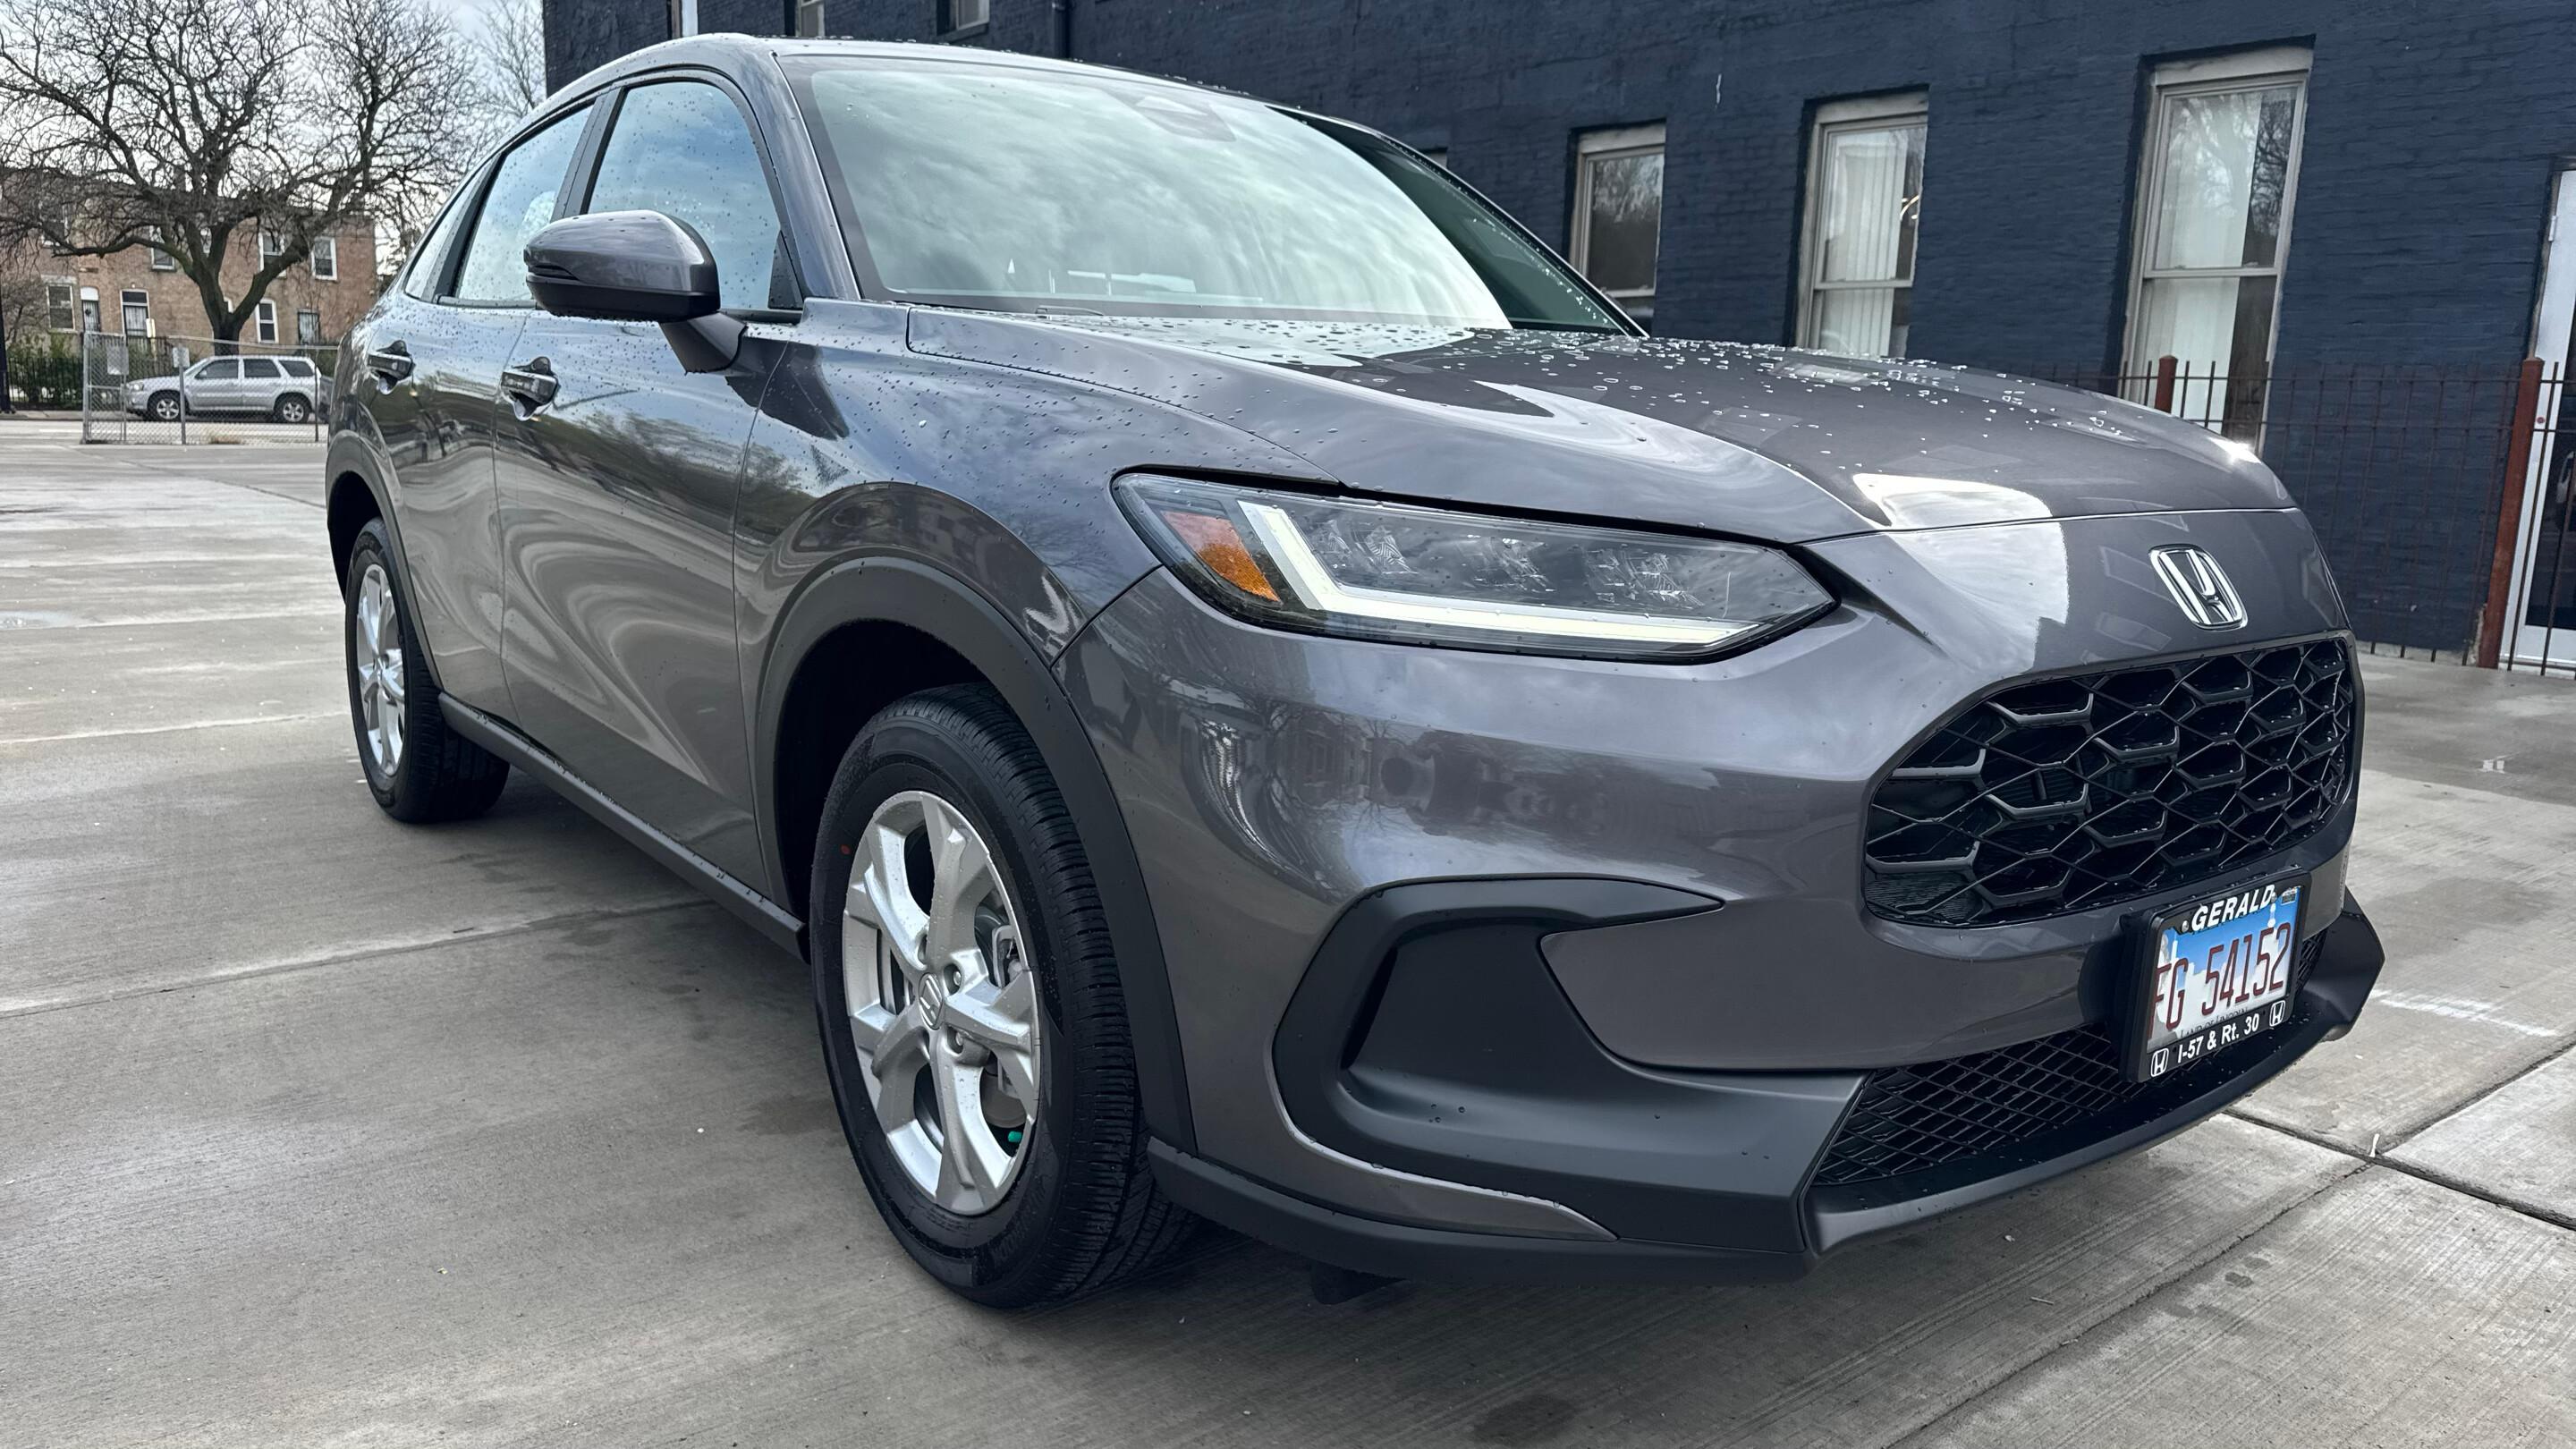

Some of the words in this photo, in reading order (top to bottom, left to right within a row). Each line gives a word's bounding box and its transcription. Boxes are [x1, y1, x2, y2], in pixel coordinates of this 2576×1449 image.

[2191, 884, 2275, 932] GERALD
[2148, 957, 2189, 1038] FG
[2201, 922, 2291, 1016] 54152
[2177, 1035, 2203, 1063] I-57
[2207, 1030, 2217, 1051] &
[2221, 1023, 2240, 1046] Rt.
[2244, 1013, 2259, 1035] 30
